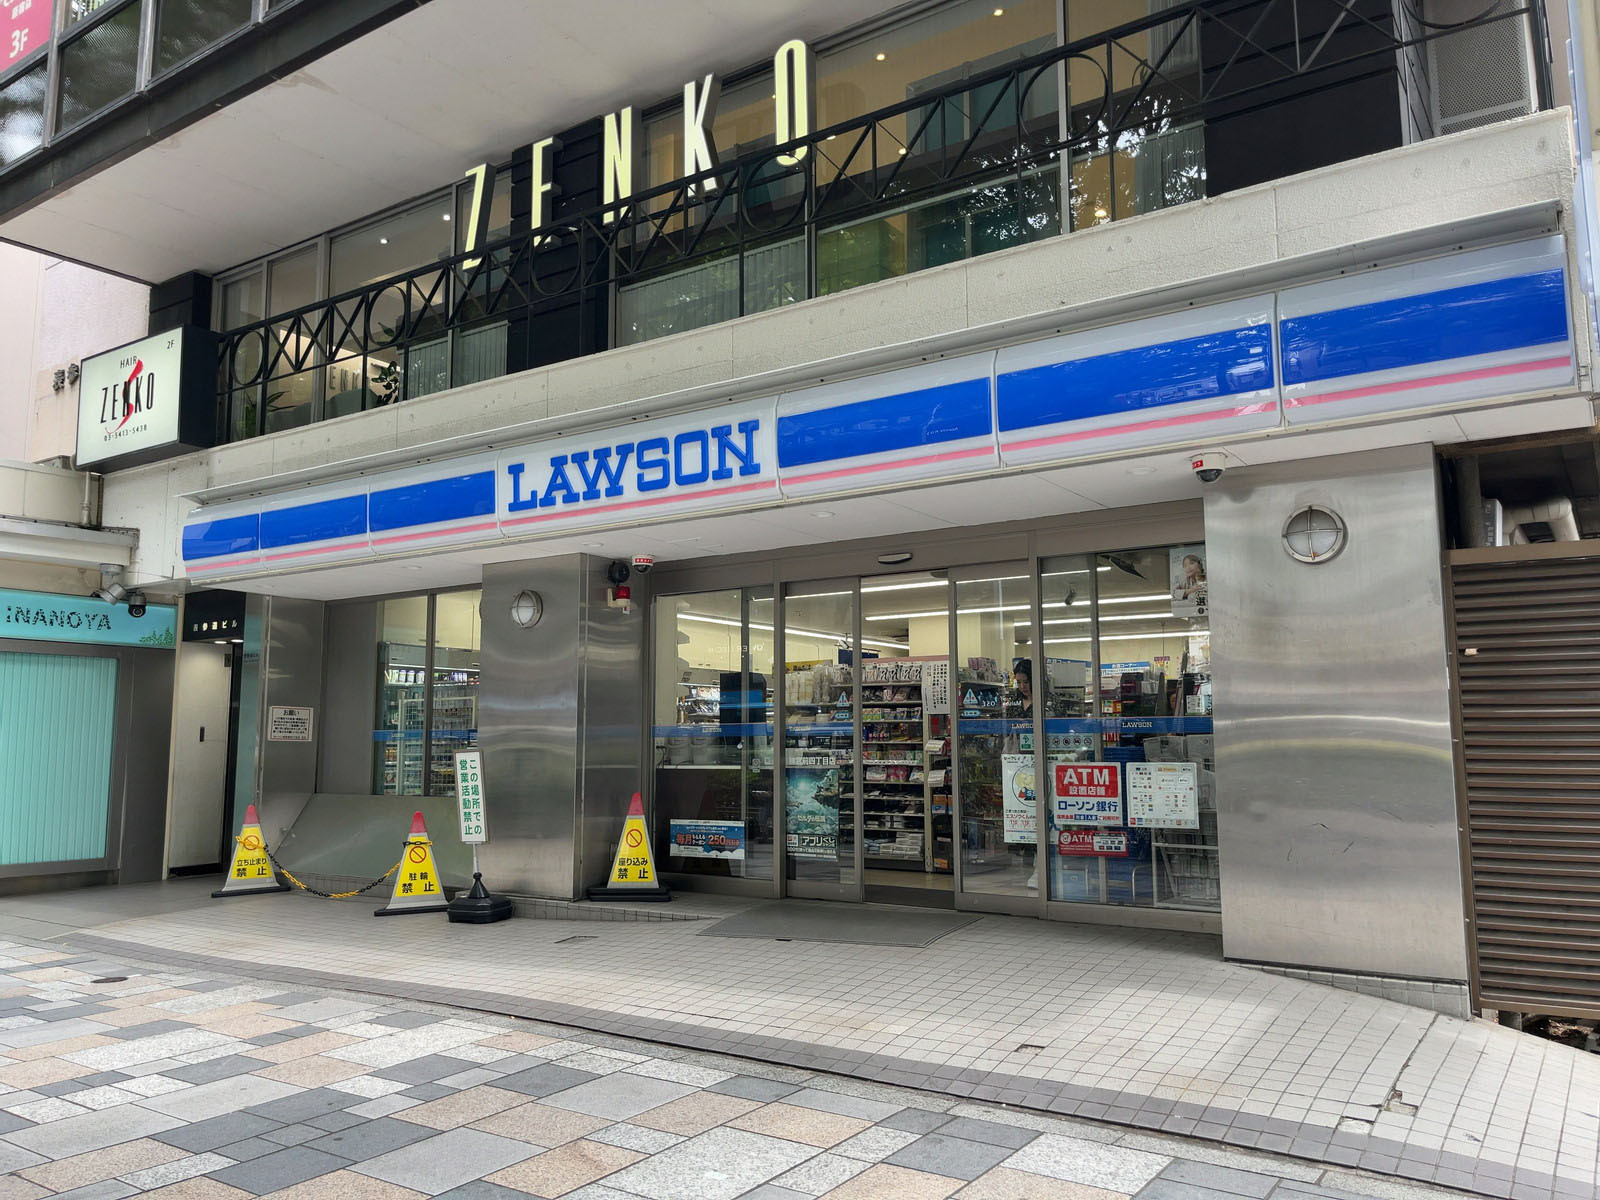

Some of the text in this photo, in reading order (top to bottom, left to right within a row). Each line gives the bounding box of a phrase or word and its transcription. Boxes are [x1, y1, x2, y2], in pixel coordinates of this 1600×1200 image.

[9, 28, 29, 58] 3F
[462, 39, 808, 271] ZENKO
[167, 340, 175, 350] 2F
[120, 356, 138, 369] HAIR
[100, 372, 154, 424] ZENKO
[507, 419, 761, 512] LAWSON
[1063, 768, 1110, 785] ATM
[1069, 785, 1106, 796] 設置店舗
[459, 759, 473, 835] 営業活動禁止
[469, 759, 482, 835] この場所での
[1058, 800, 1118, 812] ローソン銀行
[676, 834, 692, 845] 毎月
[1071, 834, 1093, 843] ATM
[237, 857, 267, 866] 立ち止まり
[618, 857, 648, 866] 座り込み
[236, 866, 267, 877] 禁止
[408, 872, 428, 881] 駐輪
[617, 868, 649, 879] 禁止
[402, 881, 435, 893] 禁止
